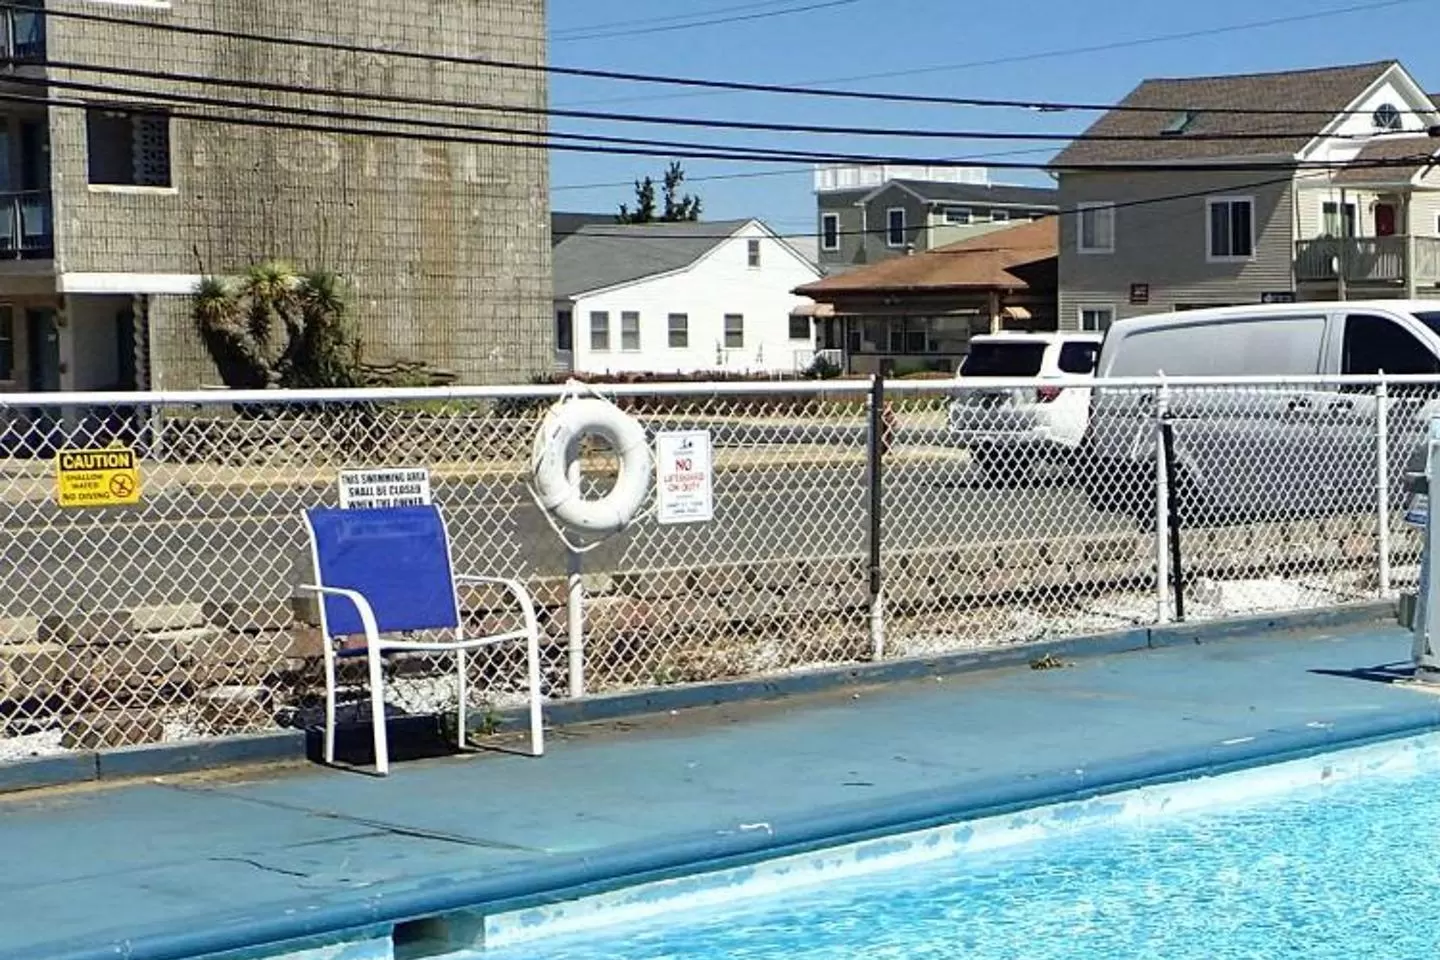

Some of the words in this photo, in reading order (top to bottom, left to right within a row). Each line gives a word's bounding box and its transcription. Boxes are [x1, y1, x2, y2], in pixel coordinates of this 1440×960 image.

[62, 453, 130, 469] CAUTION
[675, 458, 692, 471] NO
[341, 474, 359, 484] THIS
[360, 472, 404, 484] SWIMMING
[406, 471, 426, 482] AREA
[348, 486, 374, 497] SHALL
[376, 485, 387, 496] BE
[389, 484, 421, 495] CLOSED
[668, 483, 679, 492] ON
[63, 492, 76, 501] NO
[78, 491, 110, 500] DIVING
